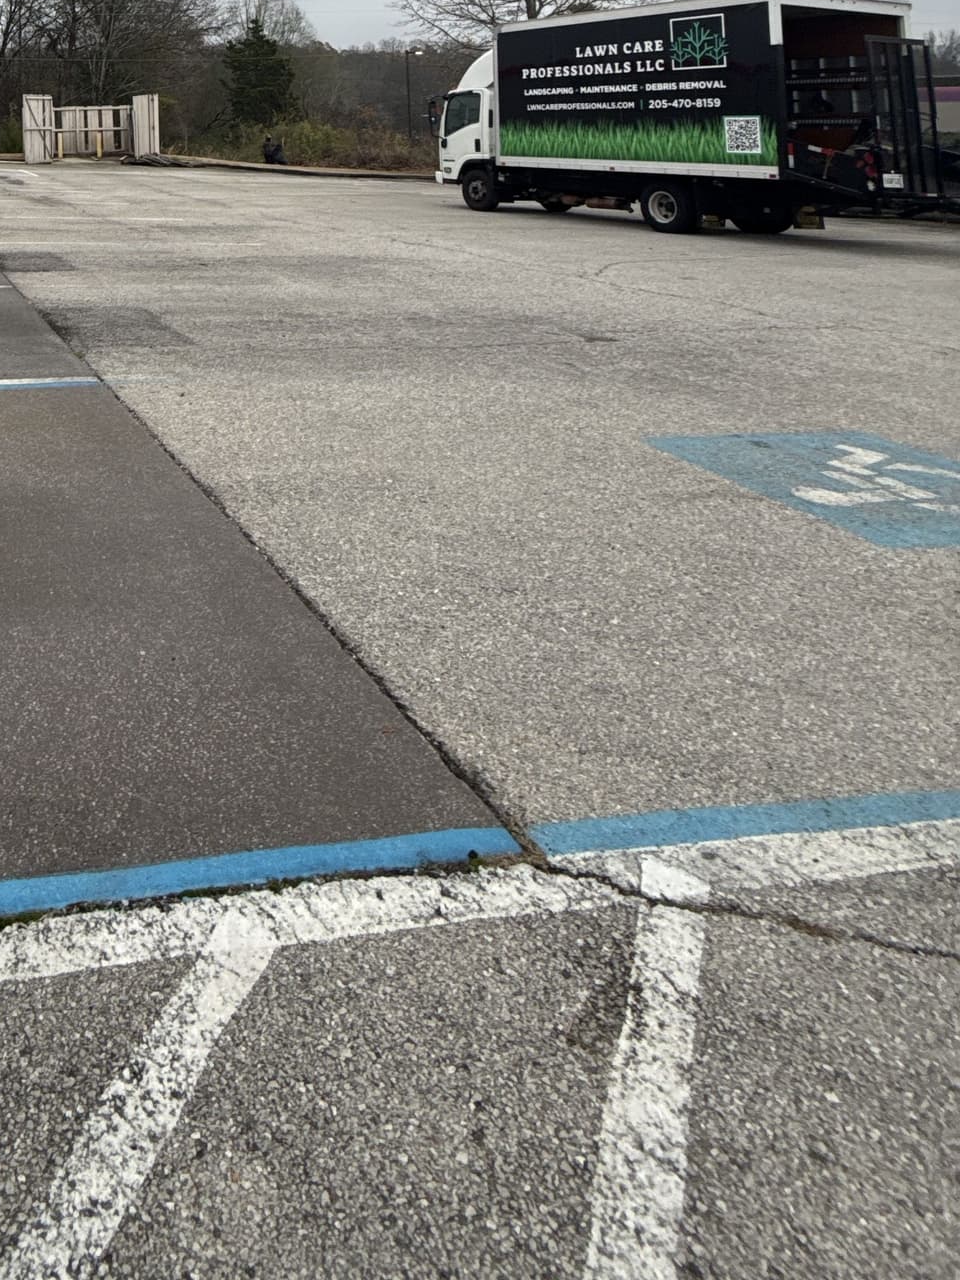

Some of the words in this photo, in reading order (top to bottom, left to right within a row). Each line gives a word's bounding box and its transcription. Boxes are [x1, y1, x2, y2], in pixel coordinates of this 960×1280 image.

[575, 43, 618, 58] LAWN
[623, 39, 665, 55] CARE
[521, 61, 632, 80] PROFESSIONALS
[636, 59, 666, 73] LLC
[524, 86, 574, 96] LANDSCAPING
[580, 84, 638, 94] MAINTENANCE
[645, 81, 677, 91] DEBRIS
[679, 80, 727, 90] REMOVAL
[648, 98, 722, 109] 205-470-8159
